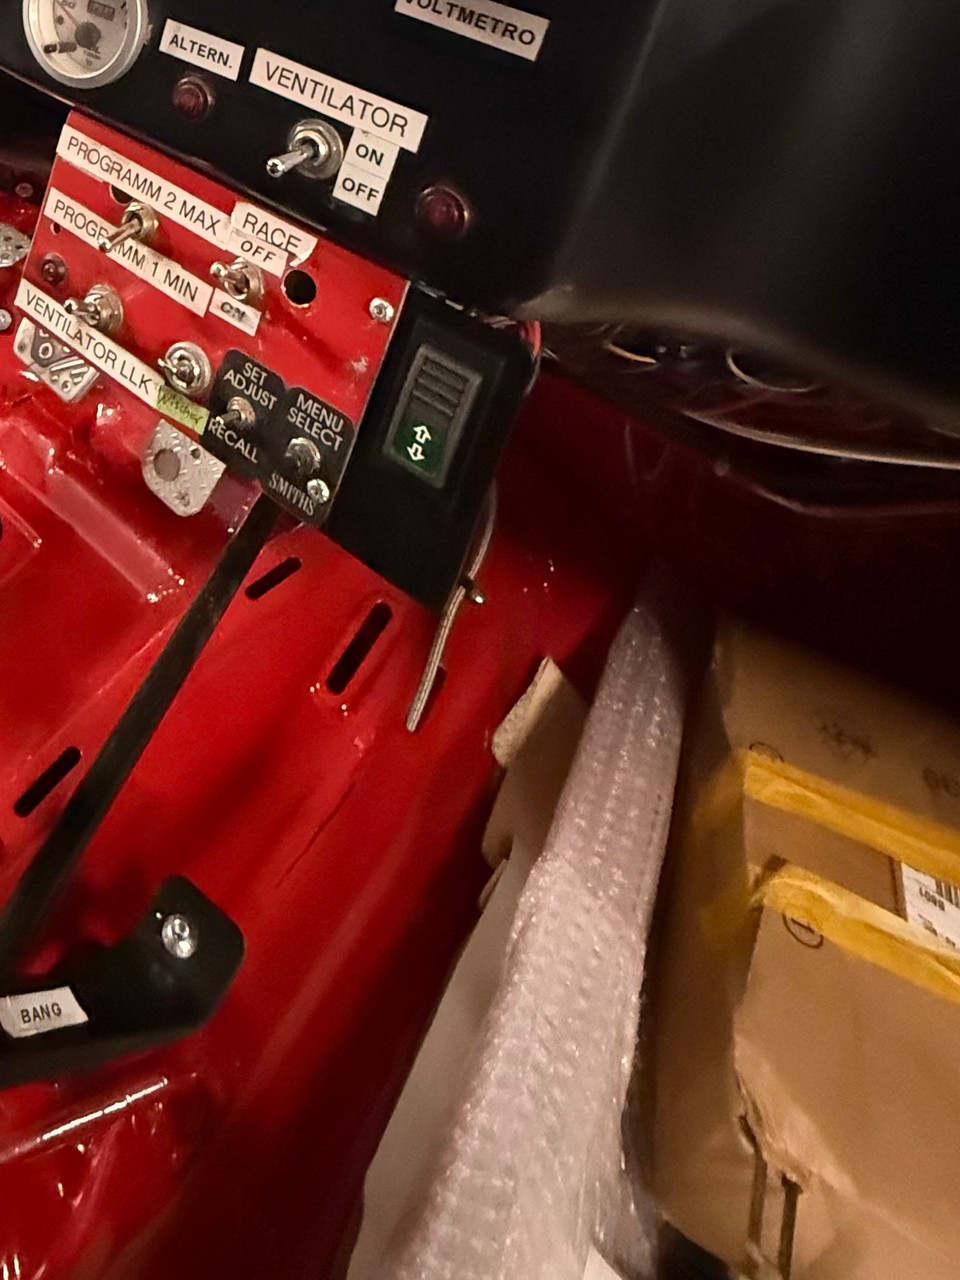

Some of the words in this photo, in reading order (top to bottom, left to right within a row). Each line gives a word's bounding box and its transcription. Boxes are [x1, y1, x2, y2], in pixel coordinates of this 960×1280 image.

[168, 33, 233, 70] ALTERN.
[266, 60, 409, 139] VENTILATOR
[355, 143, 385, 167] ON
[66, 135, 162, 203] PROGRAMM
[163, 190, 178, 211] 2
[178, 200, 222, 237] MAX
[342, 176, 380, 203] OFF
[53, 198, 147, 271] PROGRMM
[151, 260, 160, 280] 1
[161, 267, 199, 303] MIN
[240, 239, 277, 263] OFF
[242, 211, 302, 253] RACE
[26, 288, 117, 369] VENTILATOR
[119, 359, 154, 398] LLK
[223, 370, 278, 411] ADJUST
[241, 360, 268, 387] SET
[287, 407, 344, 452] SELECT
[296, 392, 345, 434] MENU
[208, 417, 259, 464] RECALL
[268, 472, 317, 517] SMITHS
[20, 1001, 63, 1025] BANG
